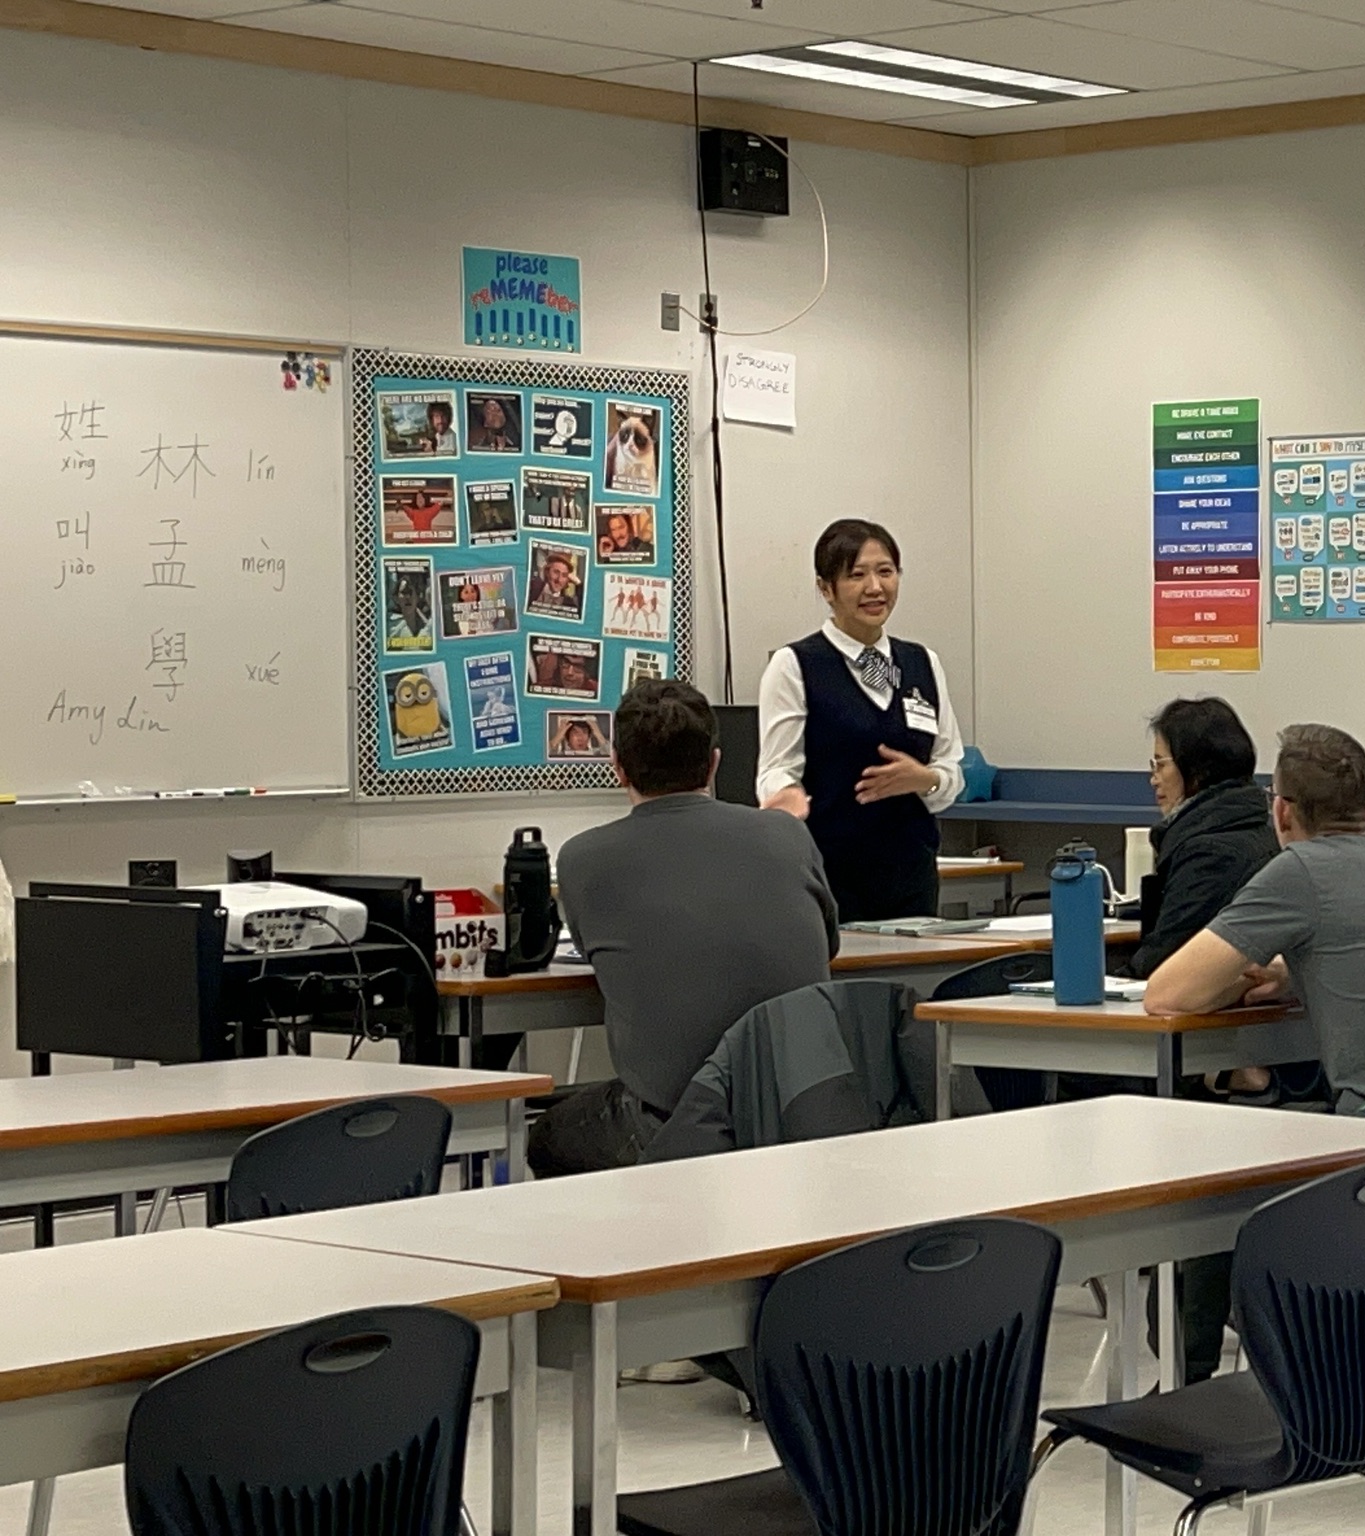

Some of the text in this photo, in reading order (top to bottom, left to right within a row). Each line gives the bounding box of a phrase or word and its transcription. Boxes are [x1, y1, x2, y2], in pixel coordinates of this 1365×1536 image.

[495, 252, 548, 278] please
[728, 373, 790, 394] DISAGREE
[54, 400, 108, 441] 姓
[136, 433, 216, 498] 林
[1312, 442, 1317, 453] I
[1333, 441, 1343, 452] TO
[56, 511, 90, 550] 叫
[143, 519, 196, 589] 孟
[145, 627, 188, 702] 學
[47, 689, 170, 745] Amy Lin
